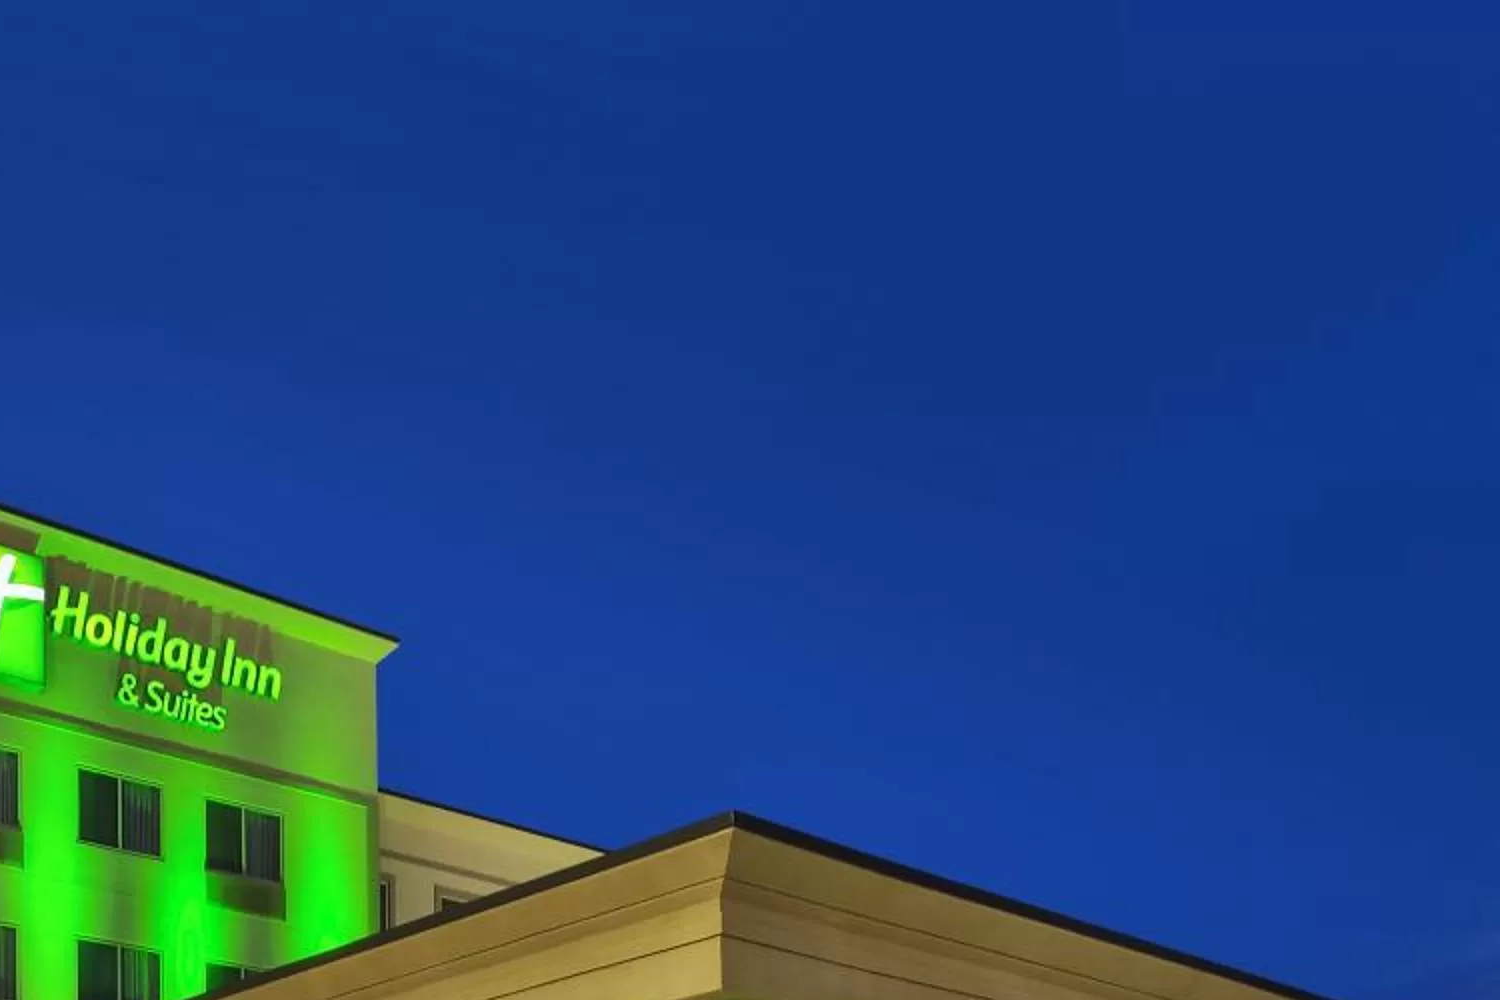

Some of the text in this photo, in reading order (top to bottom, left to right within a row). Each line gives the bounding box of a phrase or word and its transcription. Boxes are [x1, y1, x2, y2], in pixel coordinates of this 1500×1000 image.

[51, 585, 283, 701] Holiday Inn
[117, 673, 228, 732] & Suites
